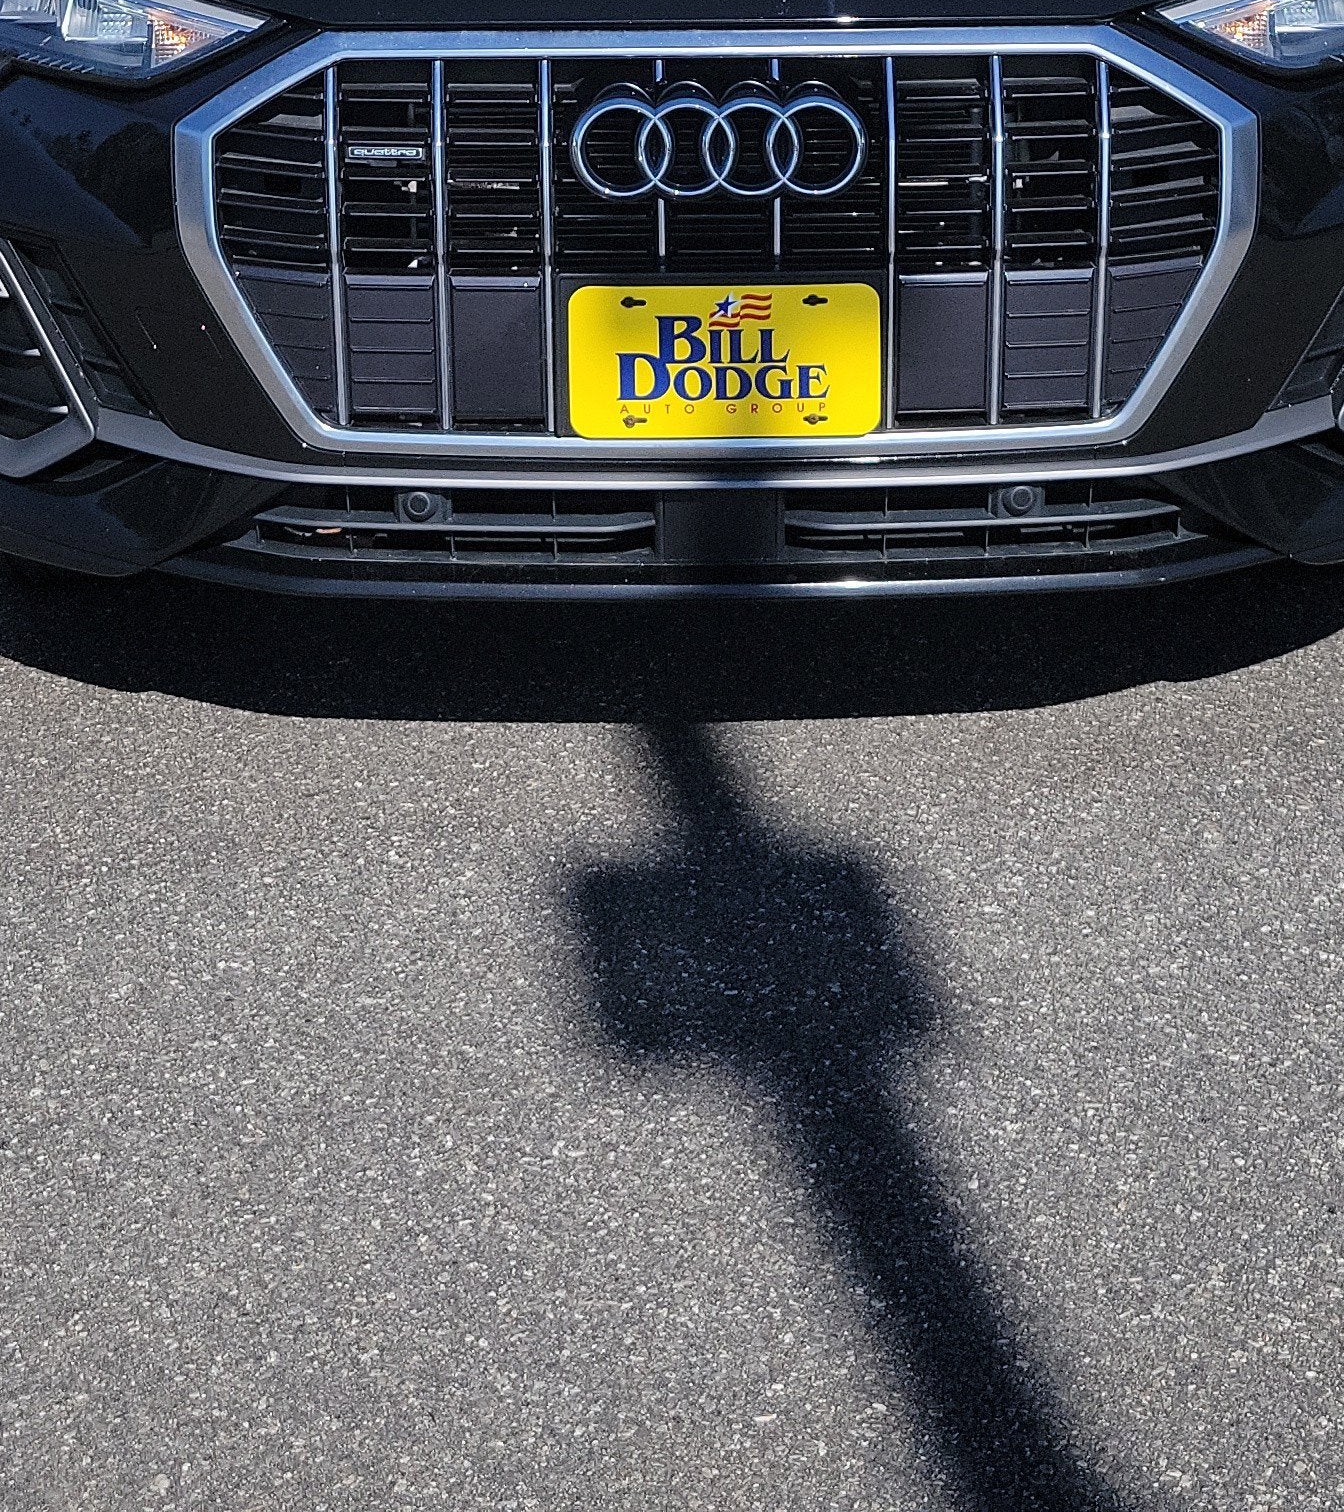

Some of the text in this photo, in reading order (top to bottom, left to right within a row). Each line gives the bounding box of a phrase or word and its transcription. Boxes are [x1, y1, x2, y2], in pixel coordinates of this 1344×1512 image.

[353, 148, 417, 157] quattro
[655, 315, 790, 364] BILL
[616, 352, 830, 401] DODGE
[618, 402, 828, 414] AUTO GROUP
